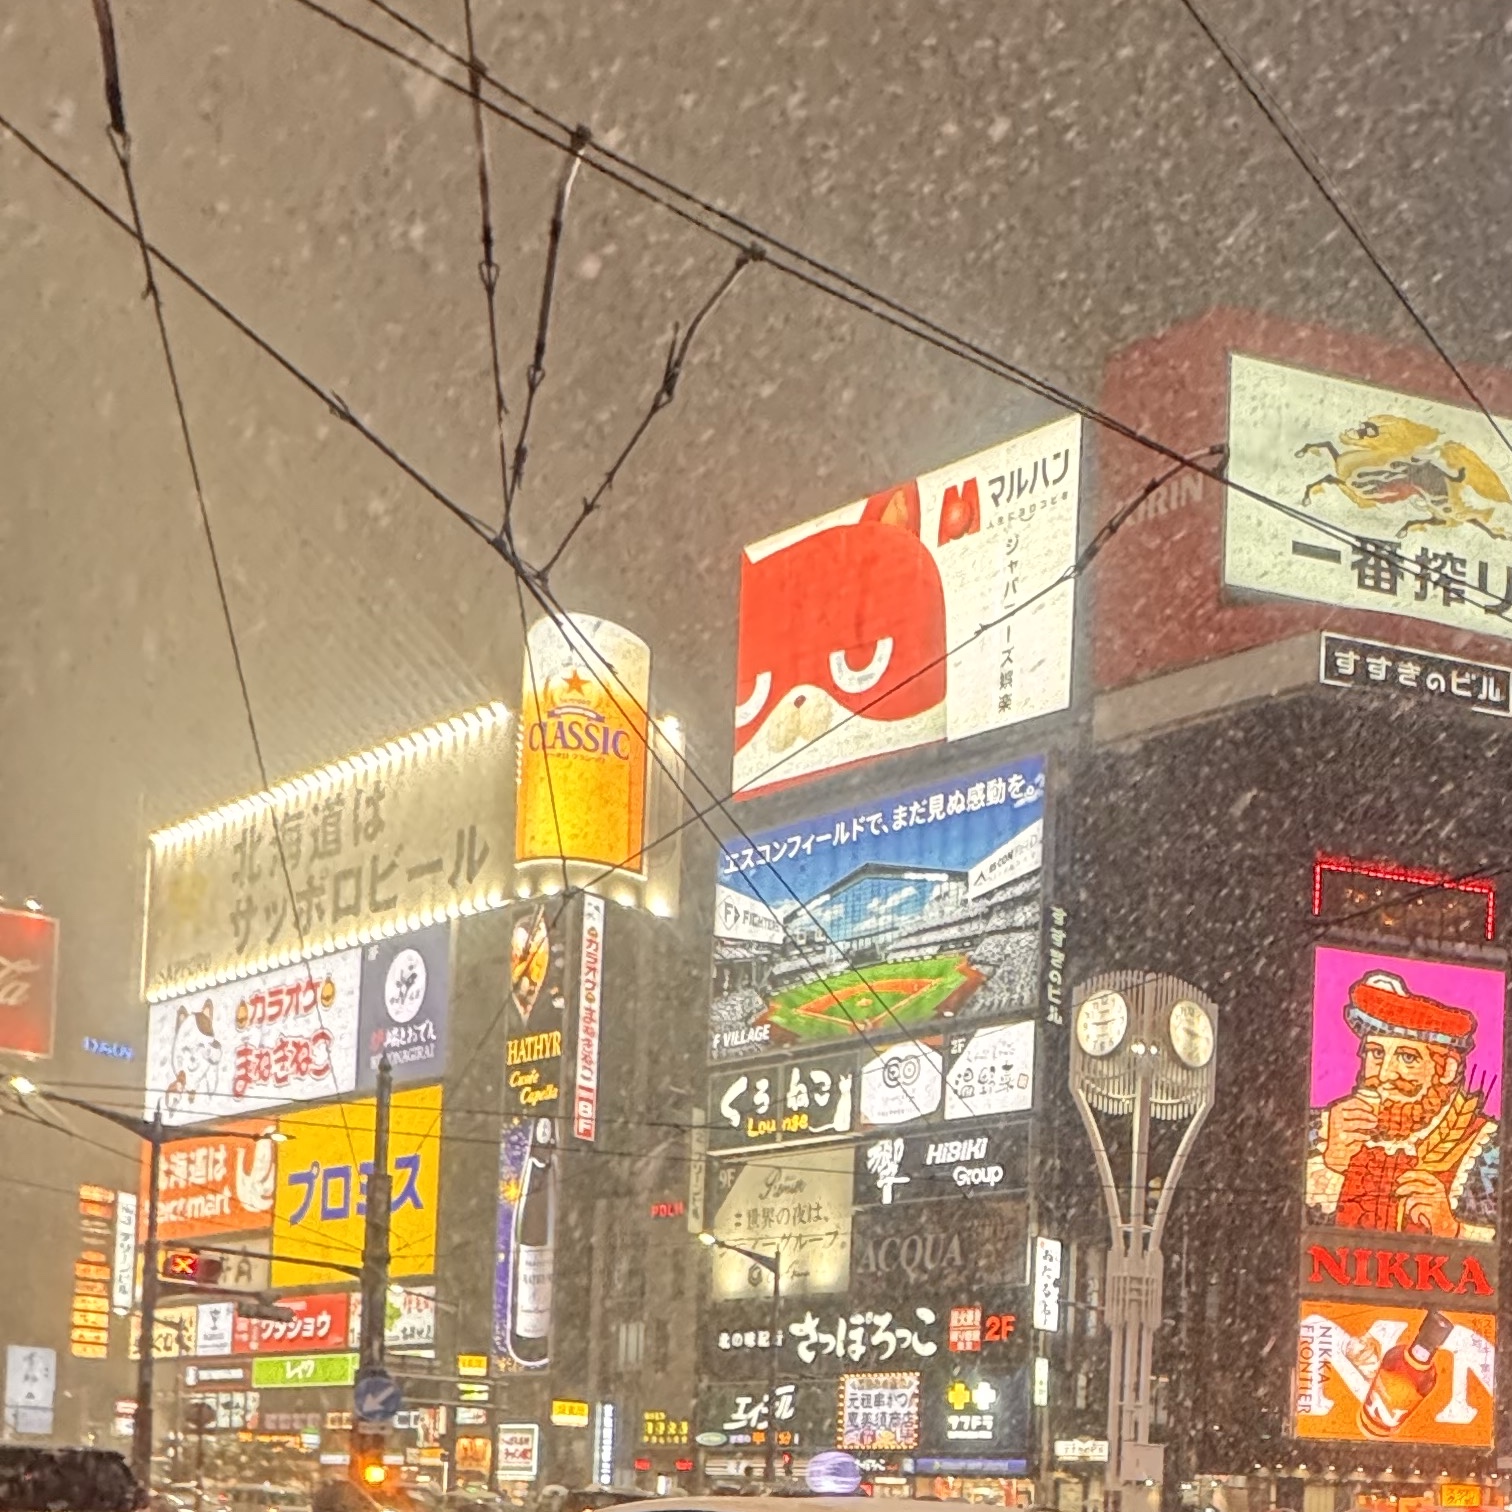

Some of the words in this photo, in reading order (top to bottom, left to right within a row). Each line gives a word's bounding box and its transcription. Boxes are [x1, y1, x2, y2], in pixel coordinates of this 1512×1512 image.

[988, 448, 1070, 508] マルハン
[1334, 650, 1501, 702] すすきのビル
[528, 720, 630, 761] CLASSIC
[231, 780, 386, 884] 北海道は
[723, 773, 1035, 874] エスコンフィールドで、まだ見ぬ感動を。
[229, 823, 491, 953] サッポロビール
[249, 977, 322, 1025] カラオケ
[505, 1030, 562, 1066] HATHYR
[723, 1024, 771, 1047] VILLAGE
[232, 1027, 333, 1100] まねきねこ
[720, 1066, 833, 1127] くろねこ
[747, 1113, 809, 1138] Lounge
[953, 1165, 1004, 1187] Group
[859, 1231, 963, 1285] ACQUA
[1307, 1244, 1495, 1296] NIKKA
[789, 1306, 938, 1363] さっぽろっこ
[985, 1313, 1017, 1341] 2F
[1297, 1324, 1315, 1414] FRONTIER
[1317, 1325, 1333, 1385] NIKKA
